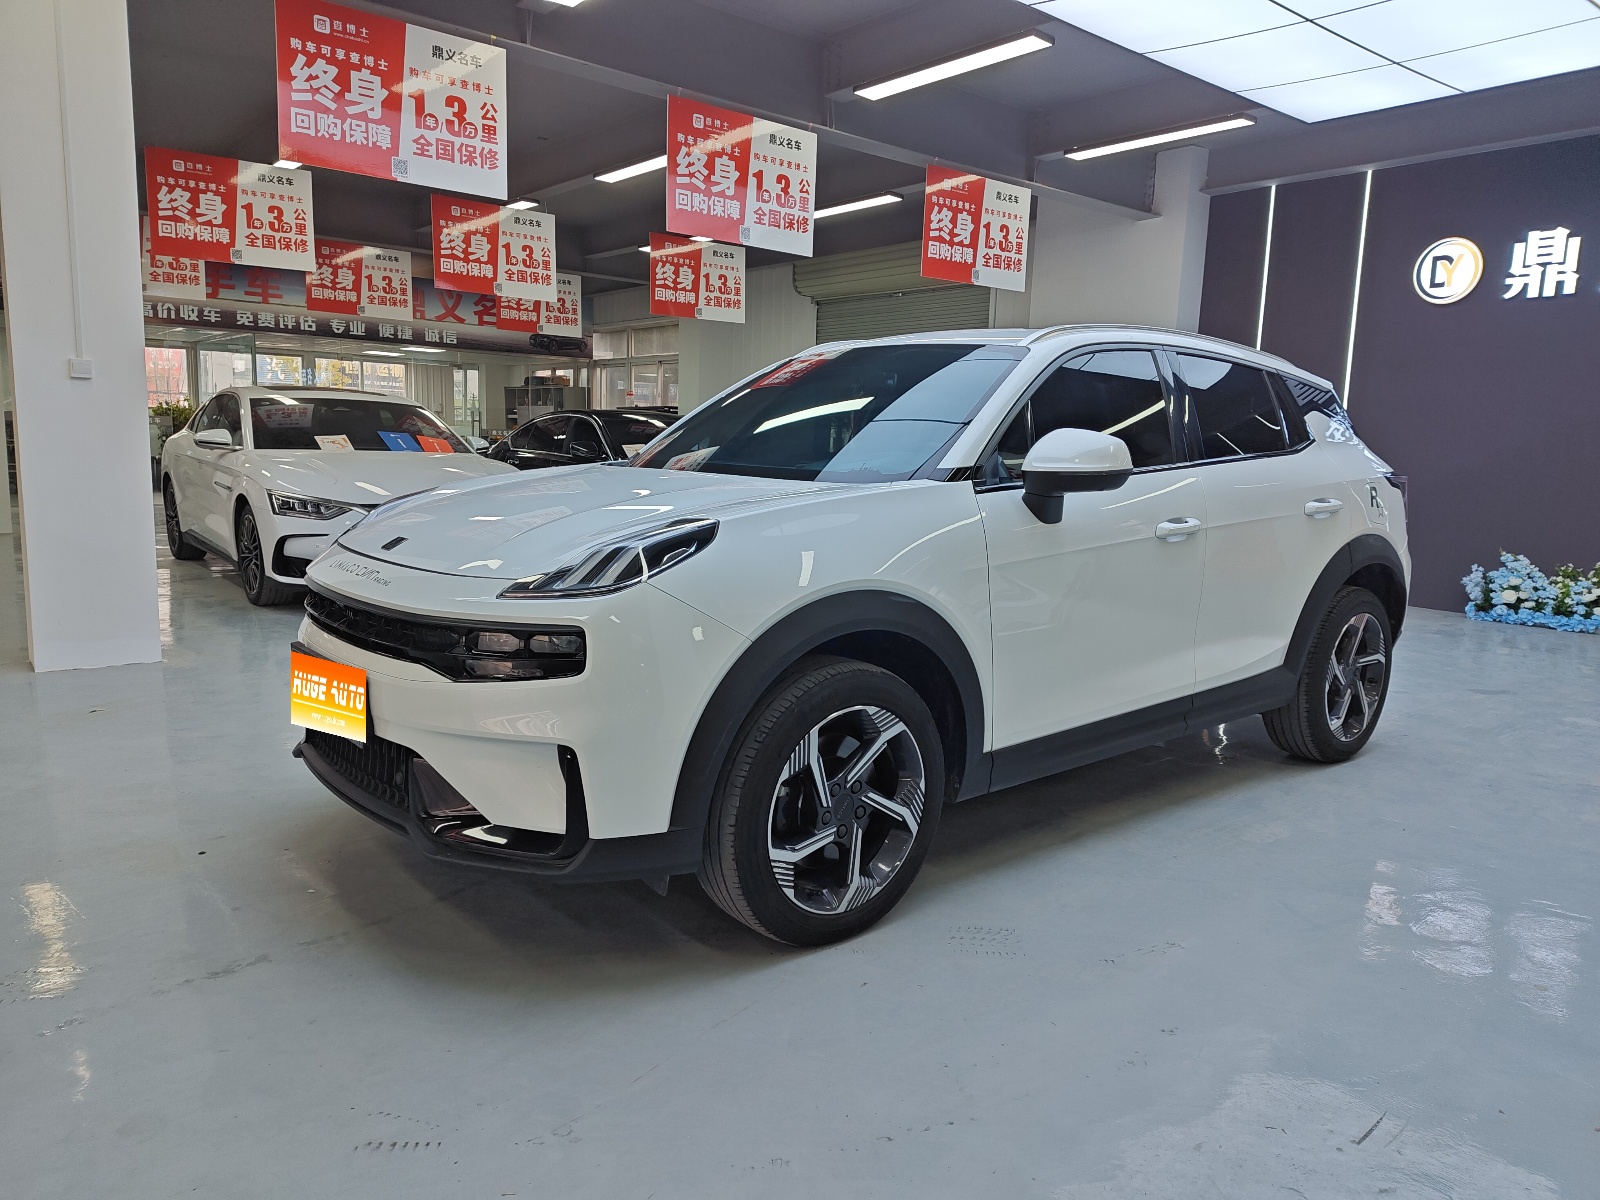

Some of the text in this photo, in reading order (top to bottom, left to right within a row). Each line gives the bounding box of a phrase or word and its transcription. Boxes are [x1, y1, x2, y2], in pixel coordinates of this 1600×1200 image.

[290, 37, 389, 71] 购车可享查博士
[432, 45, 482, 69] 鼎义名车
[290, 53, 389, 119] 终身
[409, 67, 494, 95] 购车可享查博士
[290, 107, 391, 150] 回购保障
[412, 134, 499, 171] 全国保修
[769, 134, 802, 151] 鼎义名车
[676, 146, 740, 196] 终身
[753, 152, 809, 173] 购车可享查博士
[257, 173, 294, 187] 鼎义名车
[157, 185, 228, 225] 终身
[675, 188, 741, 220] 回购保障
[157, 220, 230, 244] 回购保障
[753, 206, 810, 234] 全国保修
[930, 205, 974, 245] 终身
[244, 232, 309, 253] 全国保修
[440, 227, 491, 262] 终身
[928, 241, 974, 265] 回购保障
[440, 258, 494, 279] 回购保障
[982, 252, 1023, 273] 全国保修
[1502, 226, 1582, 300] 鼎
[149, 270, 201, 287] 全国保修
[312, 264, 355, 290] 终身
[504, 268, 552, 286] 全国保修
[655, 261, 695, 290] 终身
[311, 287, 357, 303] 回购保障
[366, 294, 409, 309] 全国保修
[655, 287, 696, 304] 回购保障
[704, 295, 741, 310] 全国保修
[500, 308, 537, 322] 回购保障
[544, 314, 579, 327] 全国保修
[236, 310, 317, 331] 免费评估
[329, 319, 366, 336] 专业
[378, 323, 413, 340] 便捷
[424, 327, 458, 345] 诚信
